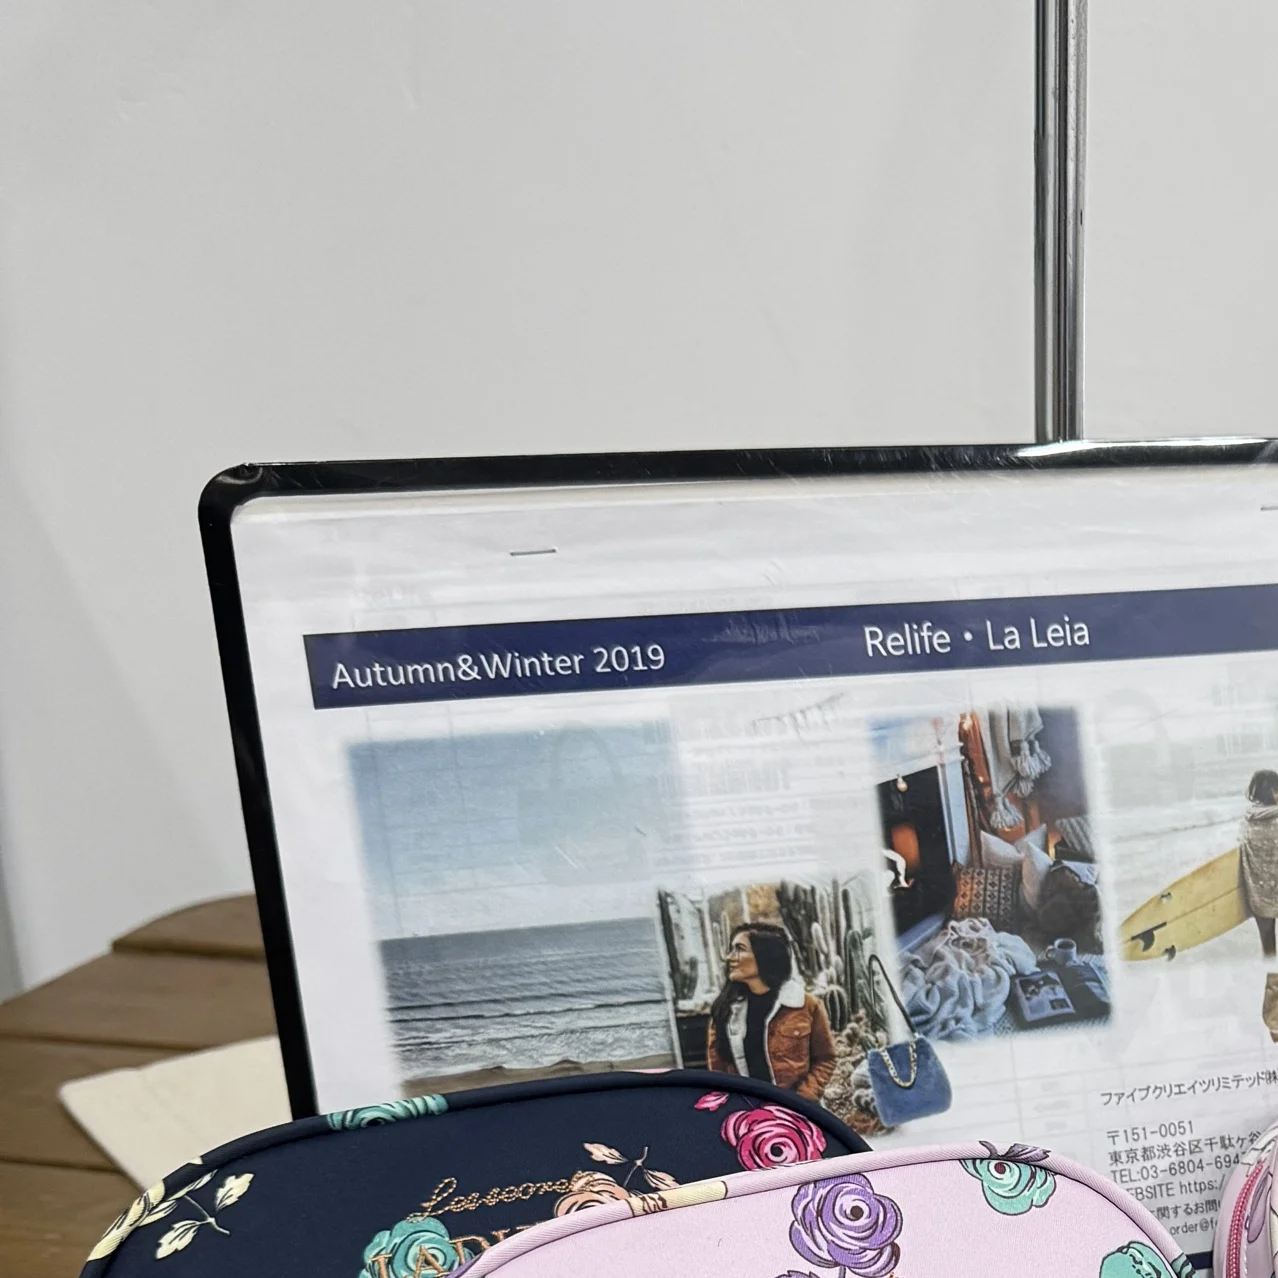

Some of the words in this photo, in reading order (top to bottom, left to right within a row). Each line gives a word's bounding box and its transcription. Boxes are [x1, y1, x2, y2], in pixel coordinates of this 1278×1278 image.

[864, 621, 951, 657] Relife
[986, 617, 1021, 650] La
[1029, 613, 1090, 648] Leia
[332, 652, 584, 690] Autumn&Winter
[593, 644, 666, 673] 2019
[1106, 1120, 1194, 1146] 〒151-0051
[1111, 1151, 1246, 1185] TEL:03-6804-694
[1126, 1181, 1175, 1202] BSITE
[1149, 1199, 1221, 1220] 関するお問
[1169, 1217, 1218, 1236] order@f
